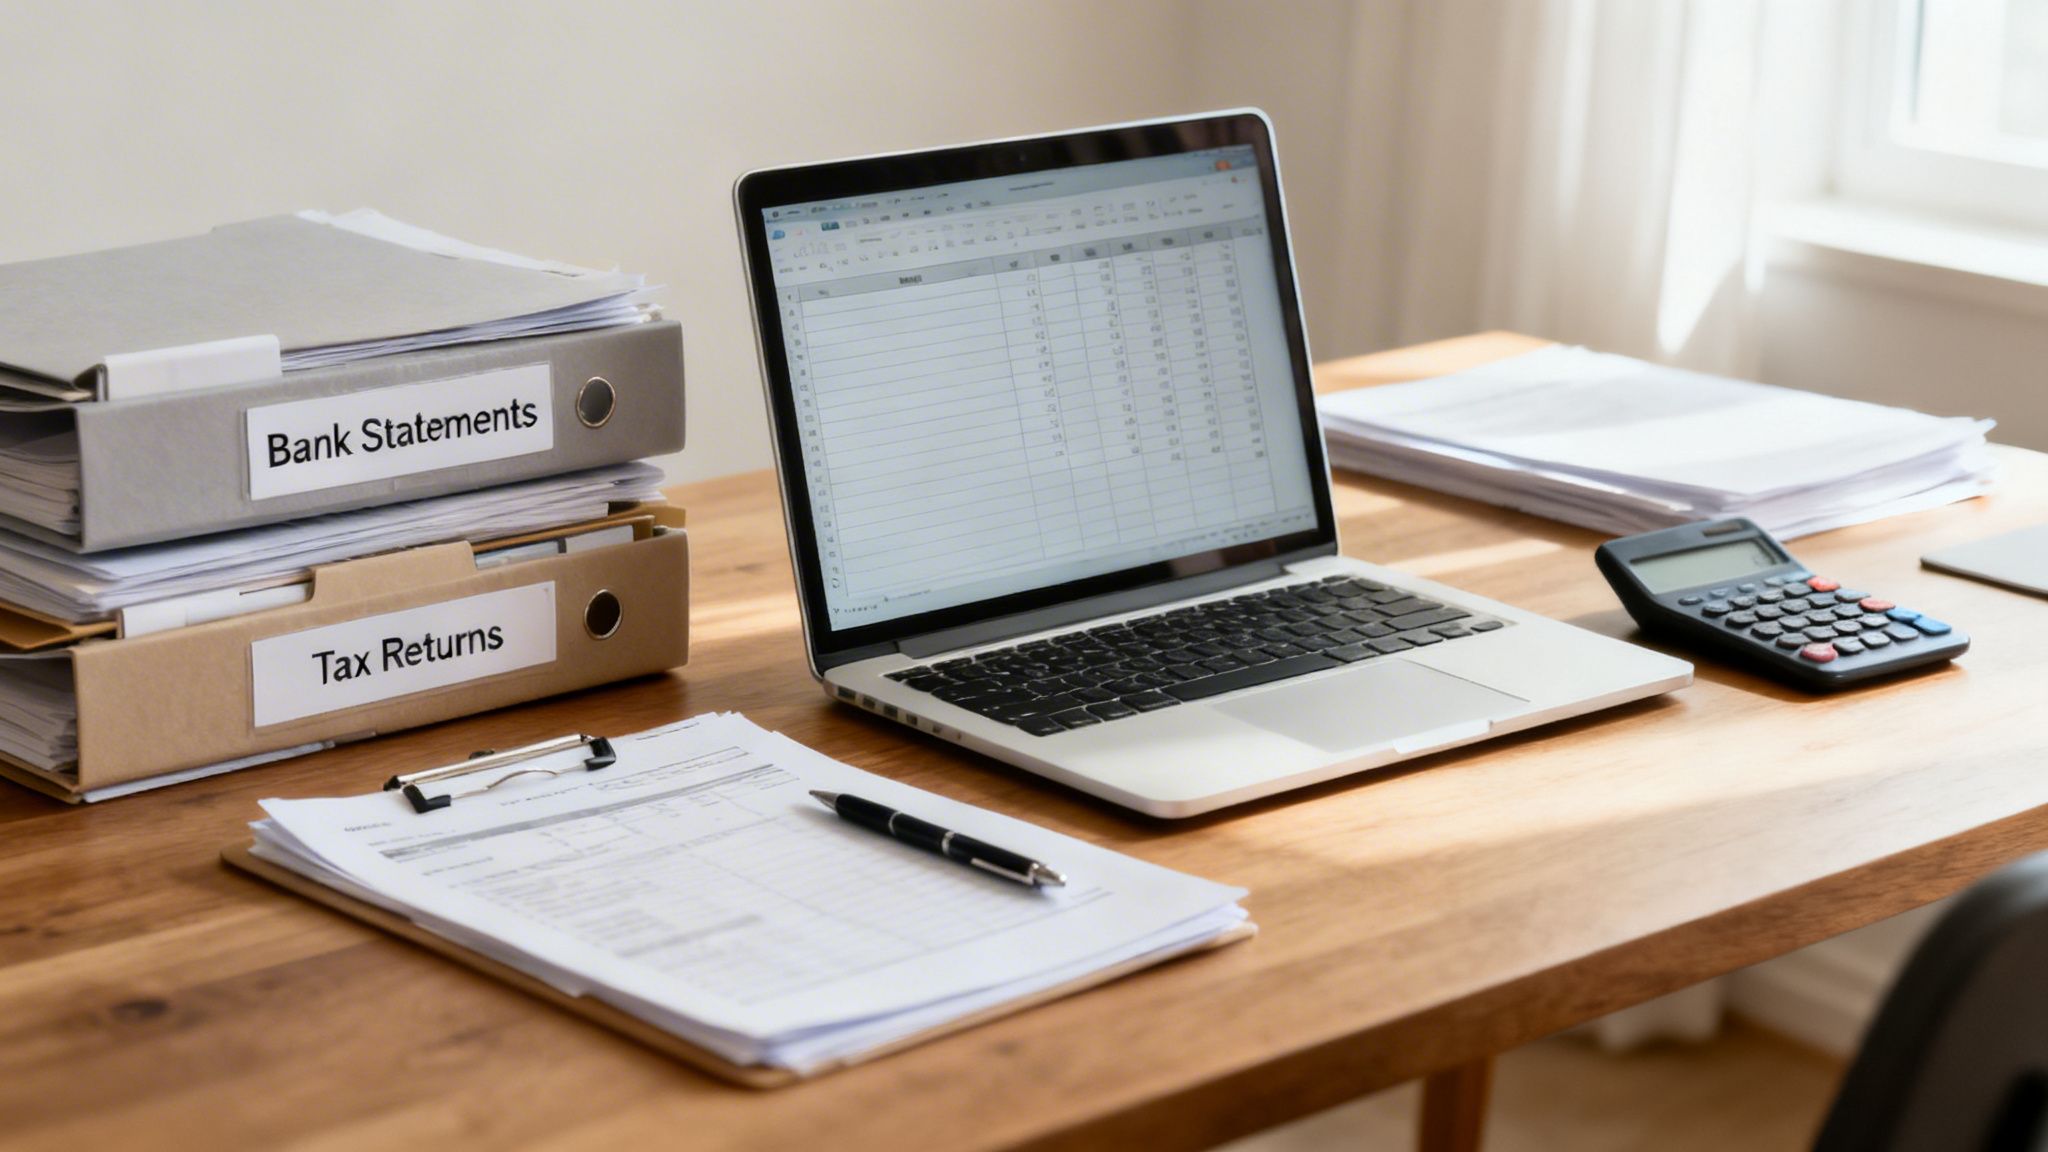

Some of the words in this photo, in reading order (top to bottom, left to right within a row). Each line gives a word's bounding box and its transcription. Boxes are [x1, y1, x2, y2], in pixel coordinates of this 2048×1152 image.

[267, 422, 353, 468] Bank
[361, 398, 538, 453] Statements
[311, 650, 371, 685] Tax
[382, 625, 504, 672] Returns
